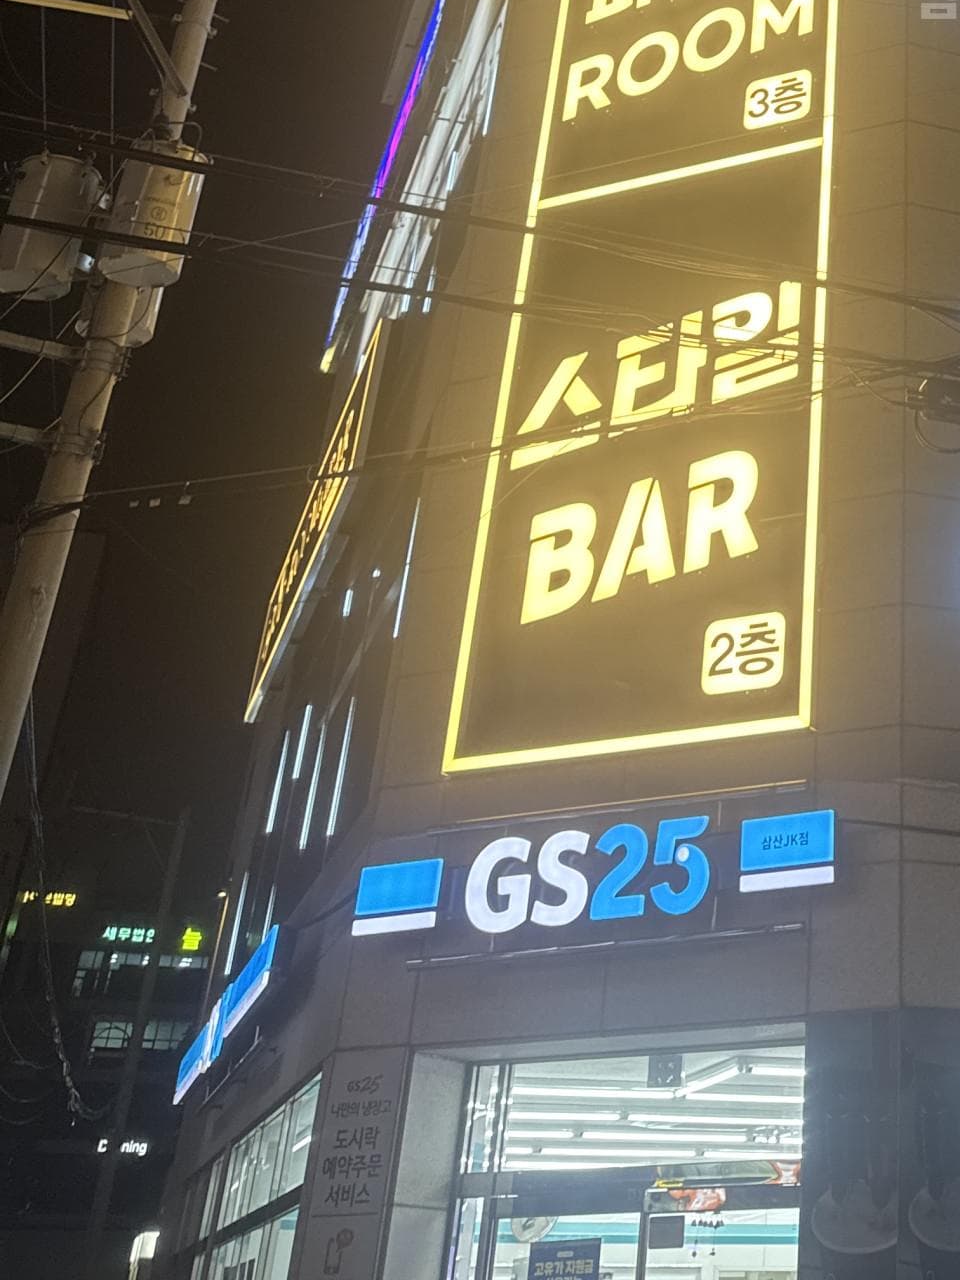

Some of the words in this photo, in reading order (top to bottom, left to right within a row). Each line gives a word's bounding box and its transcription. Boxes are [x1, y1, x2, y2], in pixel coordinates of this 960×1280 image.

[747, 77, 807, 119] 3층
[510, 280, 802, 471] 스타일
[520, 450, 759, 625] BAR
[707, 622, 780, 677] 2층
[761, 831, 809, 851] 삼산JK점
[465, 816, 710, 933] GS25
[347, 1074, 384, 1095] GS25
[333, 1126, 380, 1151] 도시락
[324, 1182, 371, 1208] 서비스
